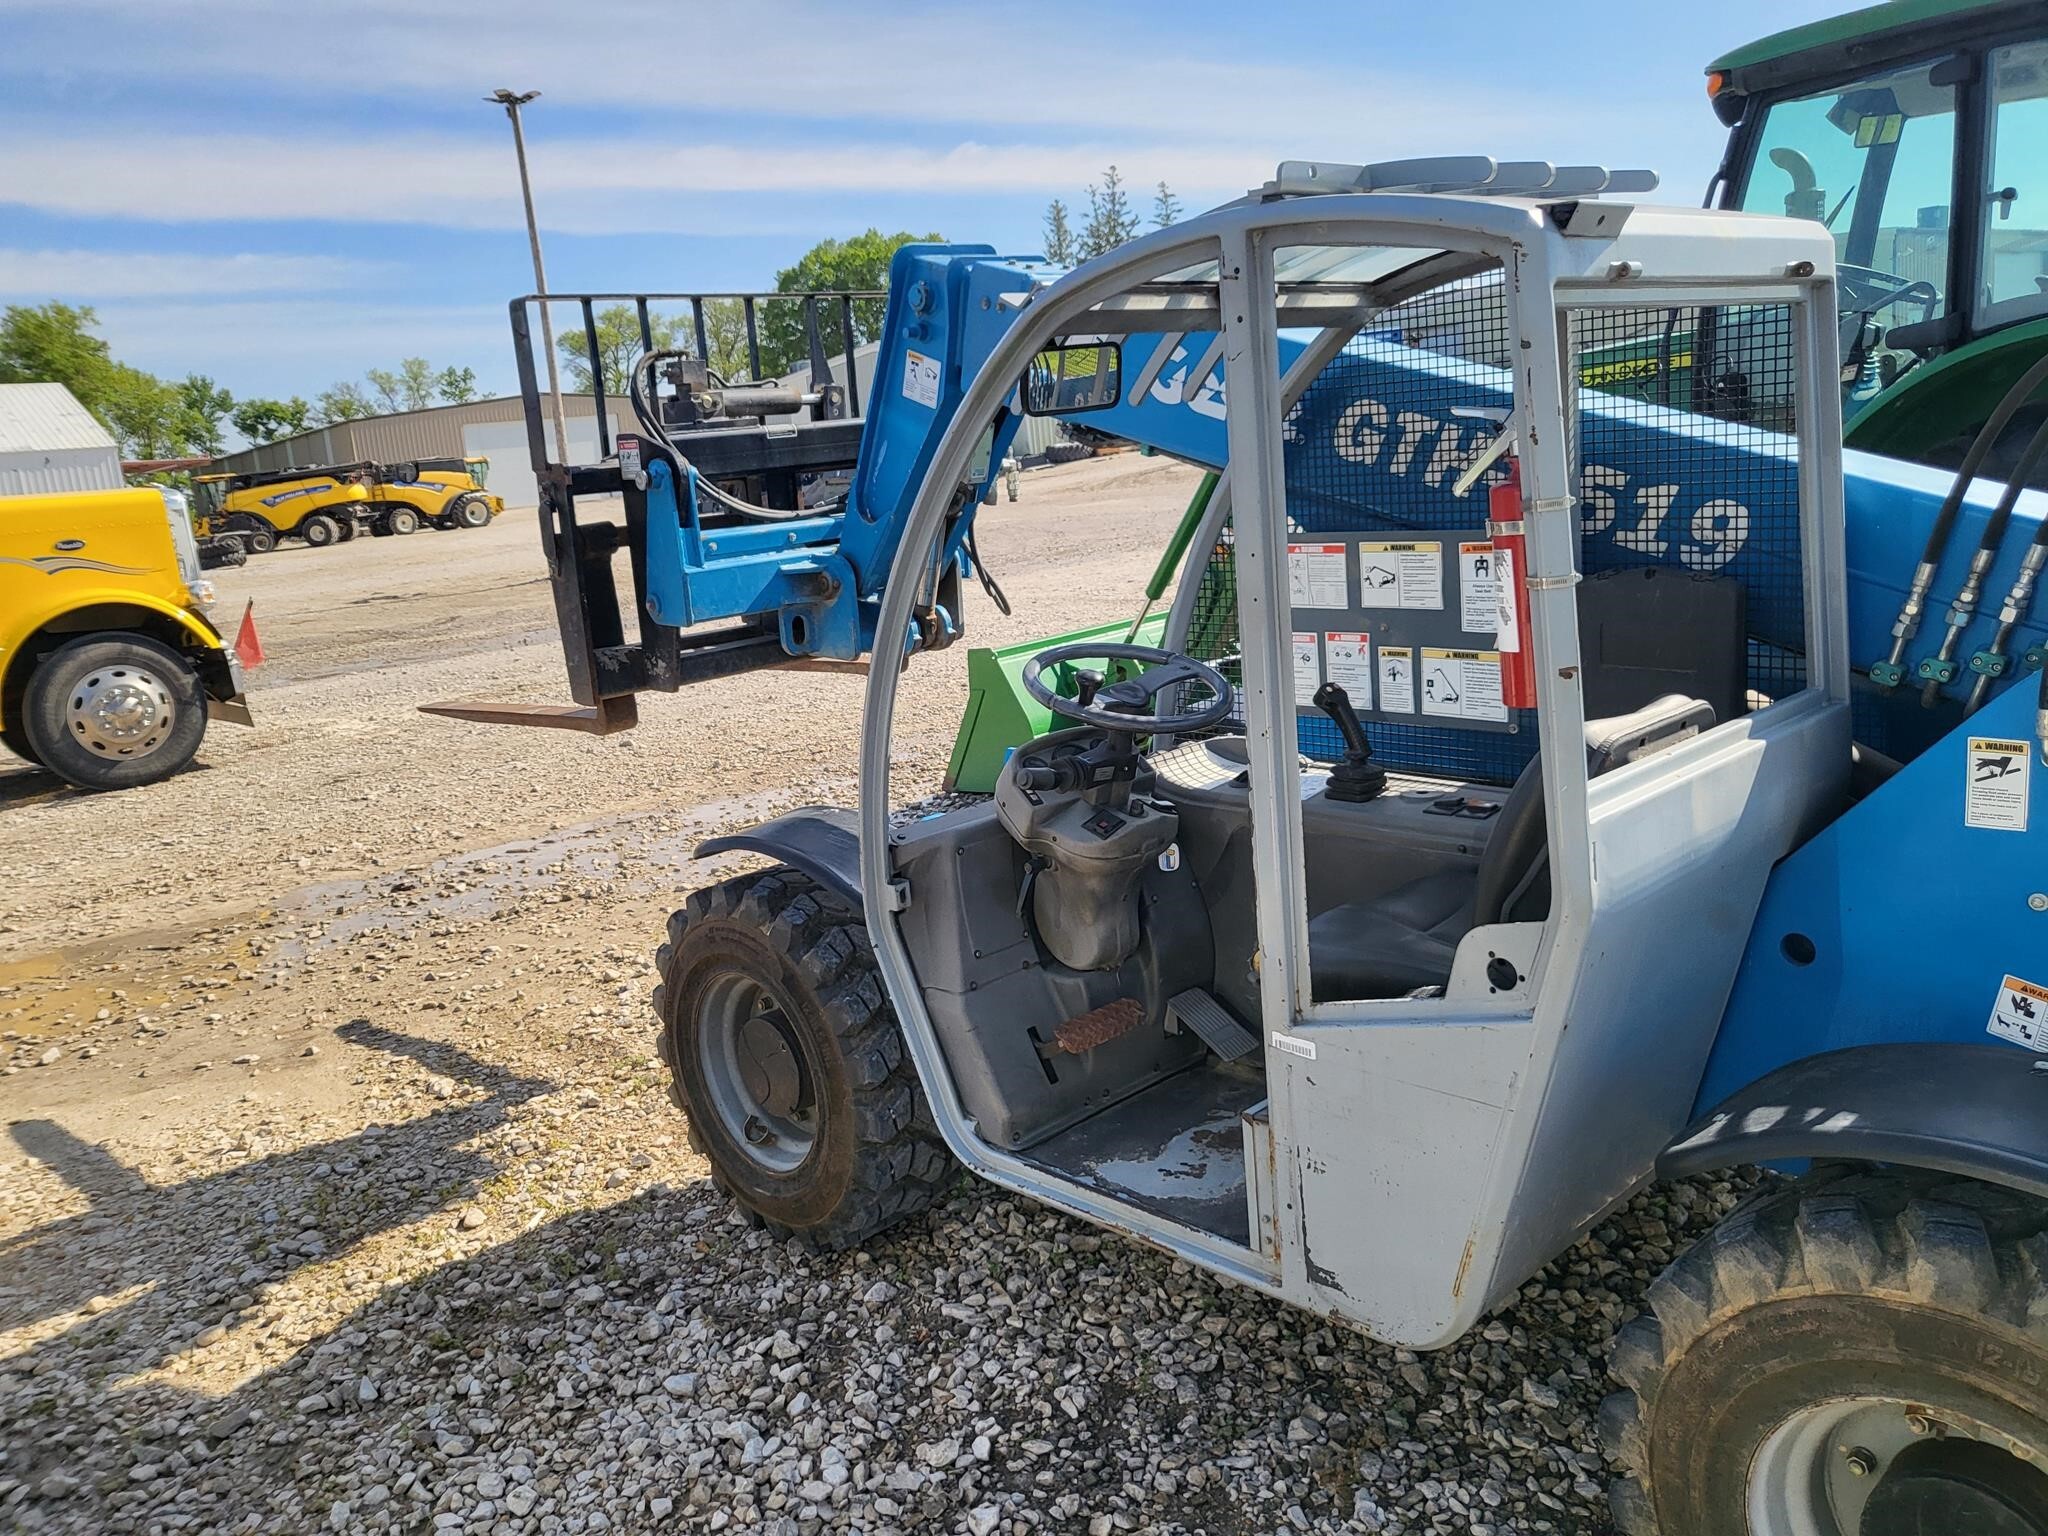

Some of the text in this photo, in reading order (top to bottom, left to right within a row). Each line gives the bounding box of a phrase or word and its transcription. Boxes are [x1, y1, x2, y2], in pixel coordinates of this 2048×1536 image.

[1390, 544, 1416, 552] WARNING
[1452, 651, 1479, 660] WARNING
[1984, 742, 2024, 753] WARNING
